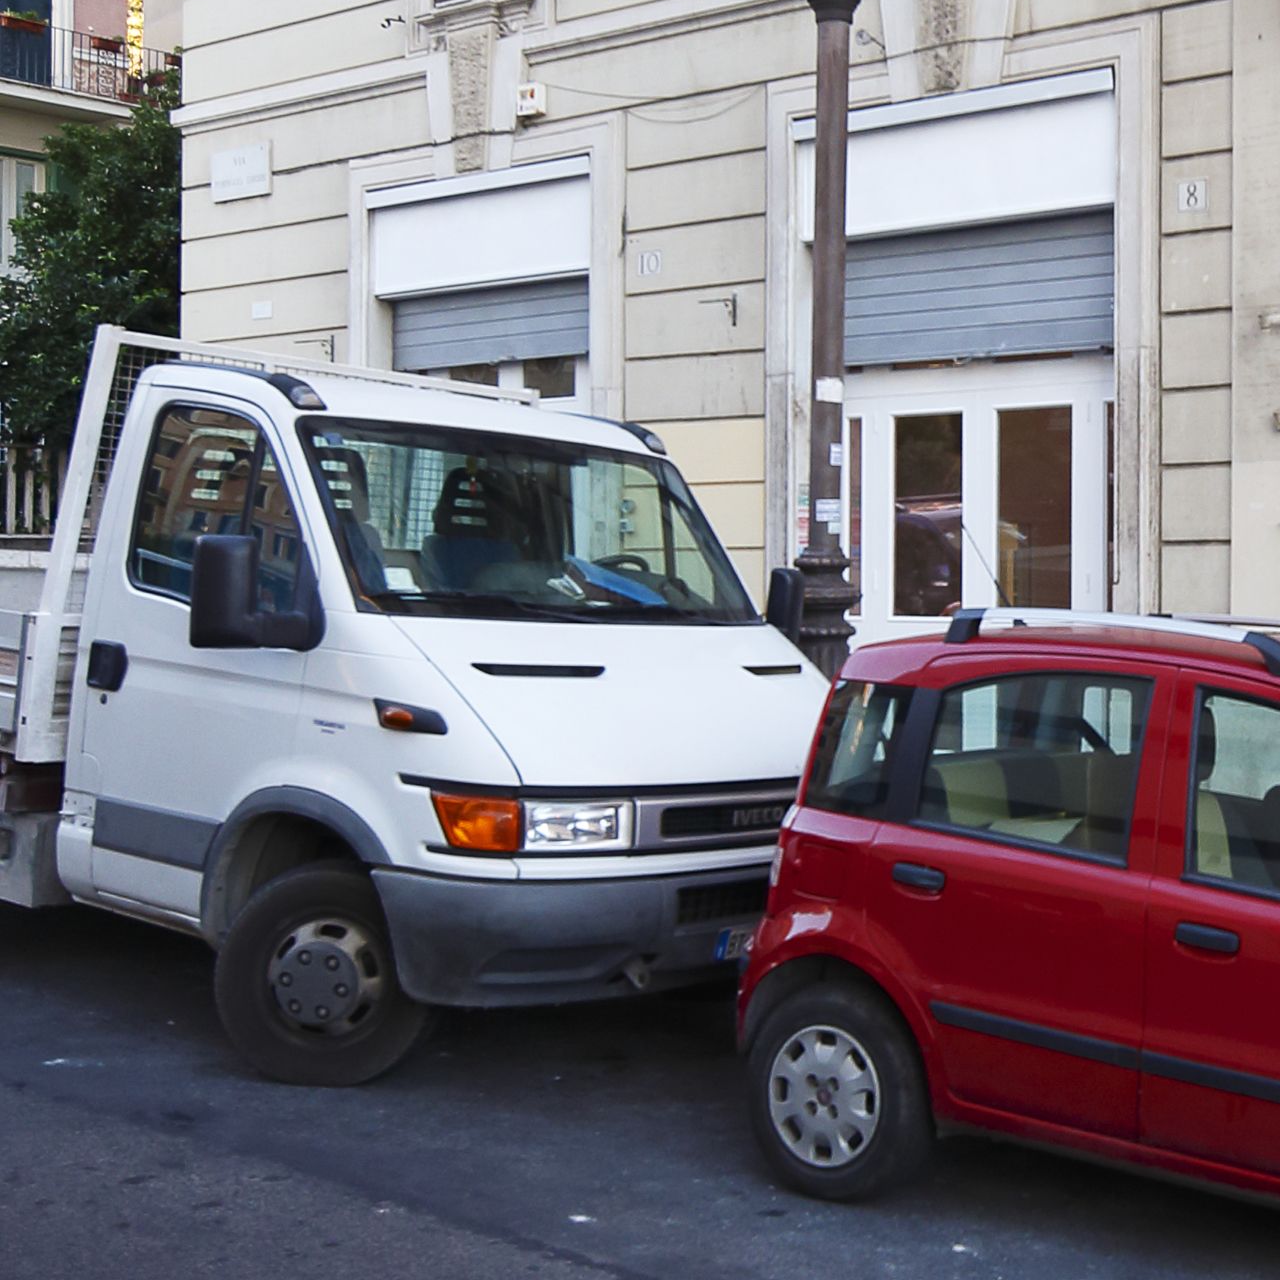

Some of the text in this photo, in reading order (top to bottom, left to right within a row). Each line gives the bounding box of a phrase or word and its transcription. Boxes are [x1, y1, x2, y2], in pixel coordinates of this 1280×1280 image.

[1186, 182, 1198, 208] 8
[640, 253, 660, 274] 10
[732, 806, 784, 827] IVECO
